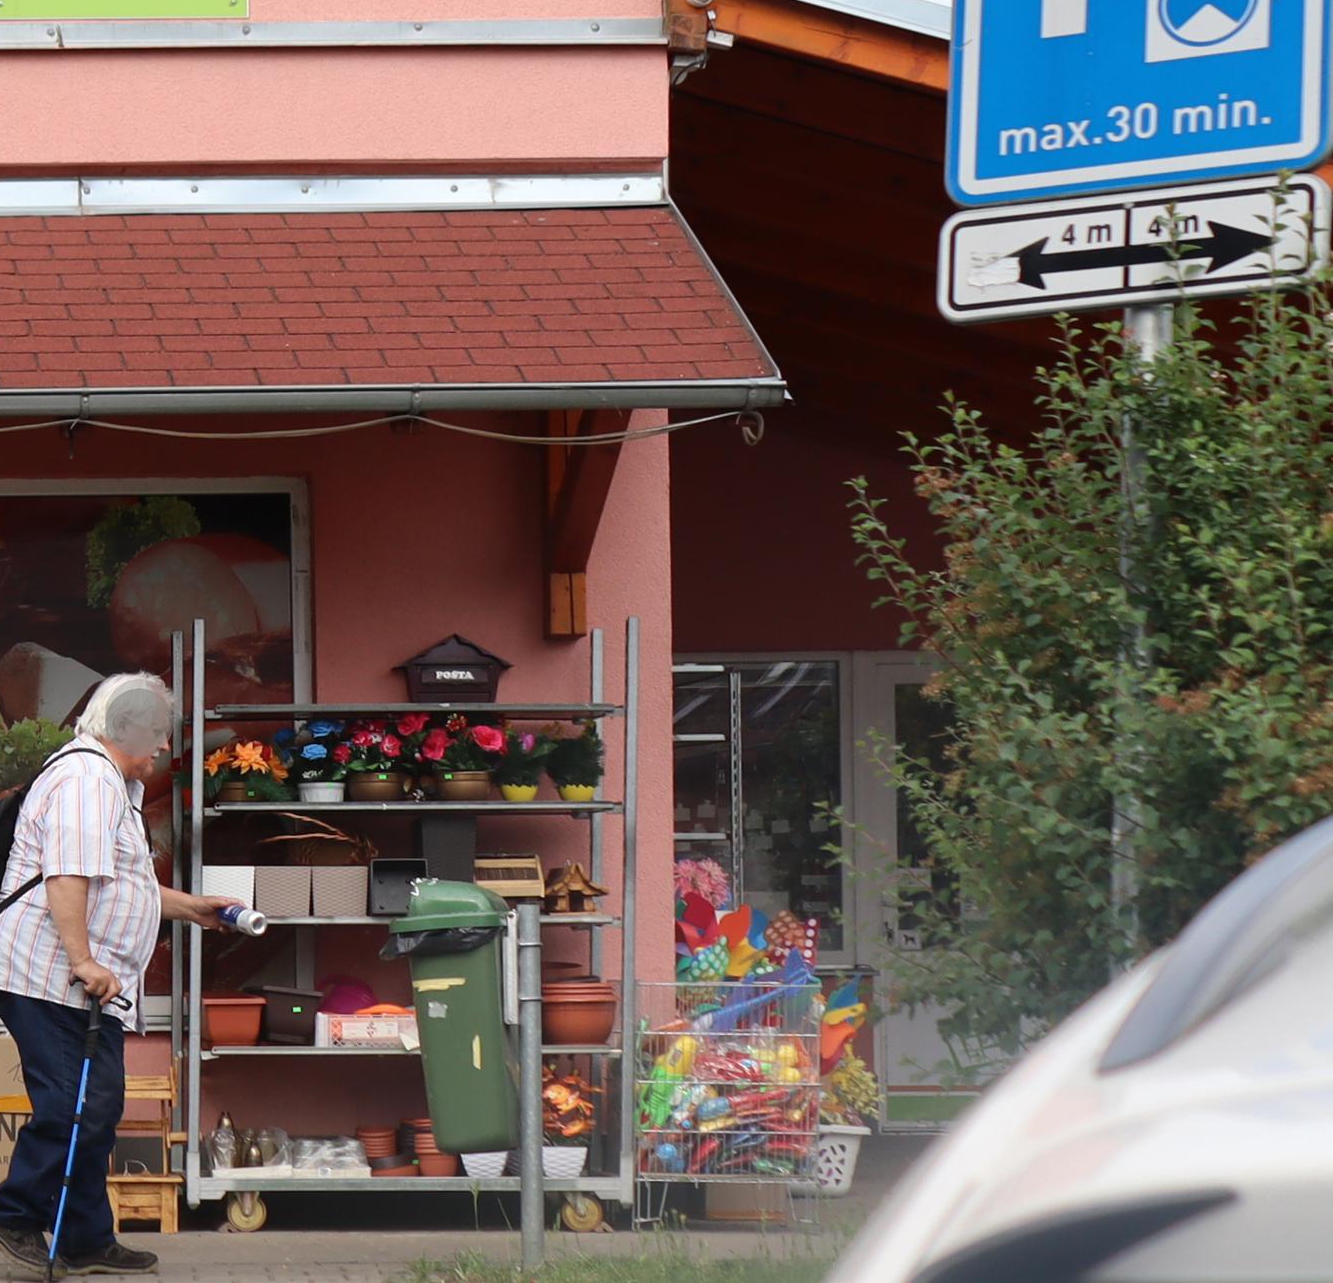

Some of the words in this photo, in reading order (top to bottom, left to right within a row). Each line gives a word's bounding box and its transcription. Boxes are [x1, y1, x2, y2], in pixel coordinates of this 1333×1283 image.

[999, 102, 1158, 156] max.30
[1172, 93, 1272, 135] min.
[1061, 223, 1077, 245] 4
[1087, 222, 1112, 244] m
[1148, 215, 1163, 237] 4
